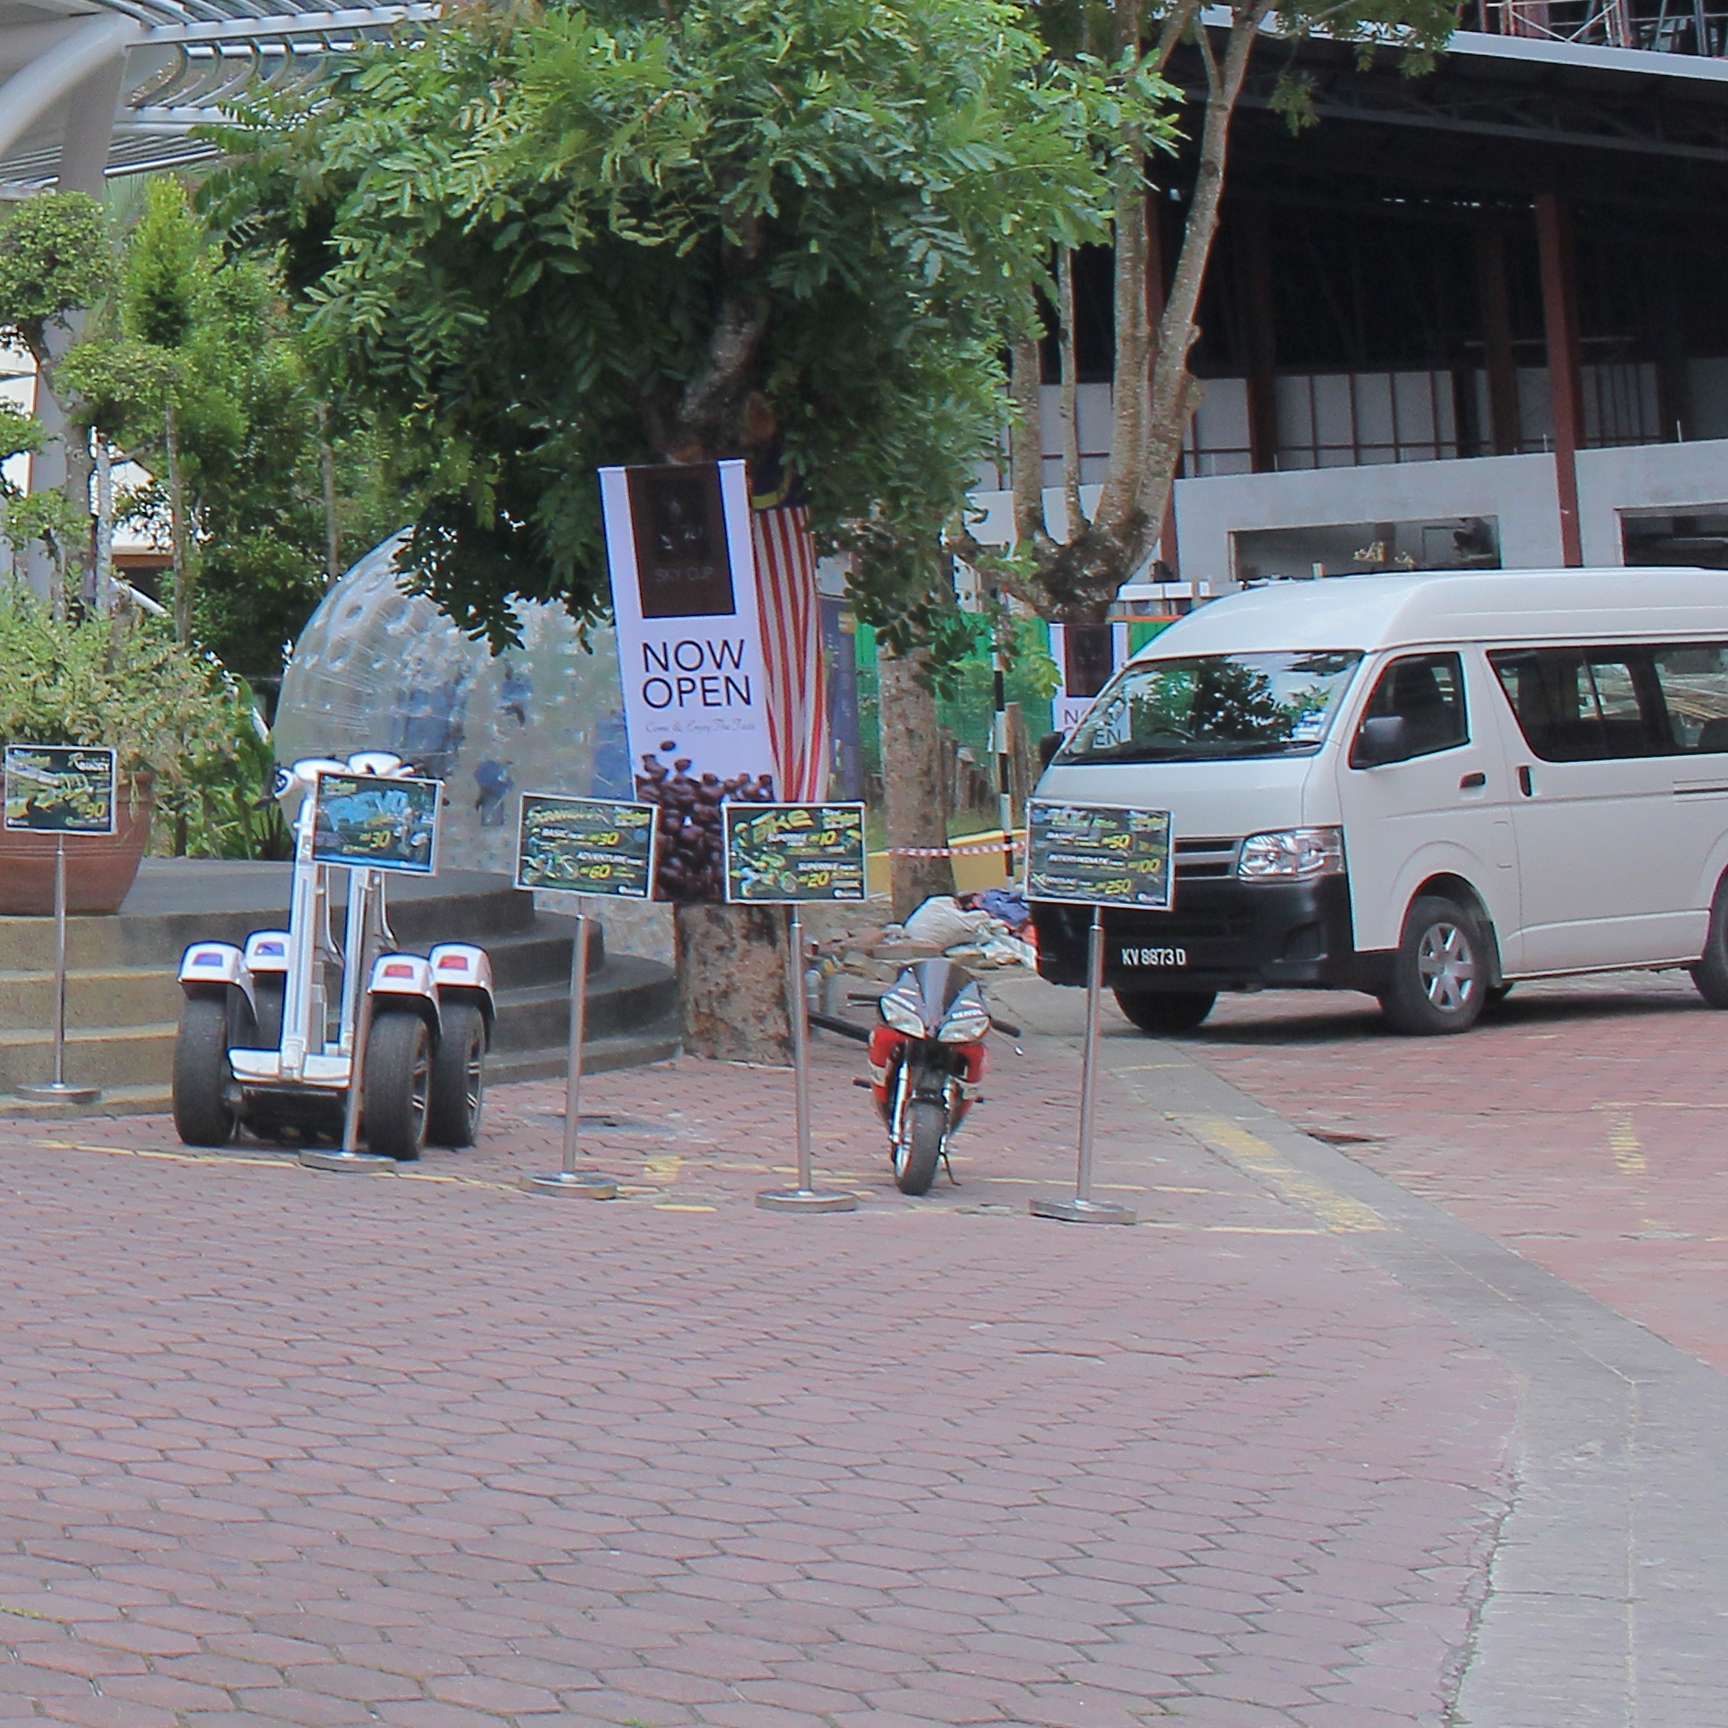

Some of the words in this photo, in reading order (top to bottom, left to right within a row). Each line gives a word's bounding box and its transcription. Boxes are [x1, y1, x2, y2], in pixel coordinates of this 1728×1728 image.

[642, 639, 745, 673] NOW
[642, 675, 752, 709] OPEN
[1121, 948, 1139, 965] KV
